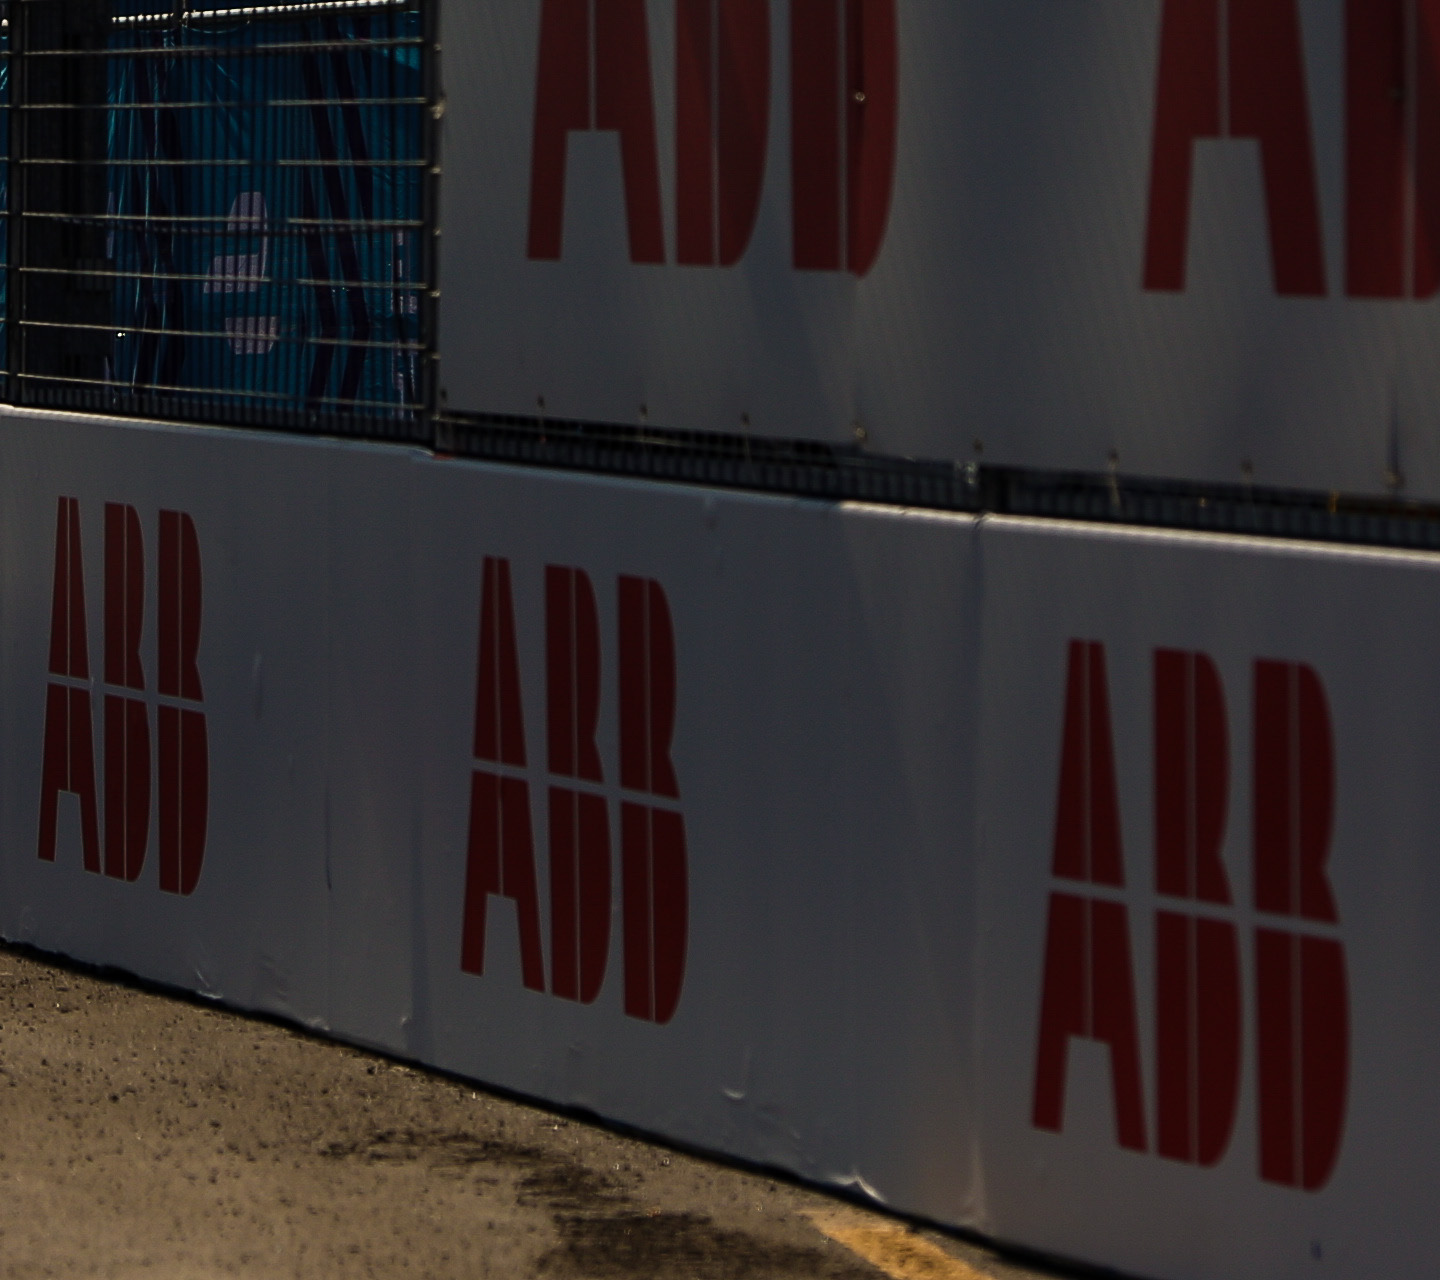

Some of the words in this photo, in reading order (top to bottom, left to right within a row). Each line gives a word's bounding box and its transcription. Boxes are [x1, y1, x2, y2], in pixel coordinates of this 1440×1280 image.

[38, 496, 208, 895] ABB
[461, 558, 688, 1025] ABB
[1032, 641, 1350, 1191] ABB
